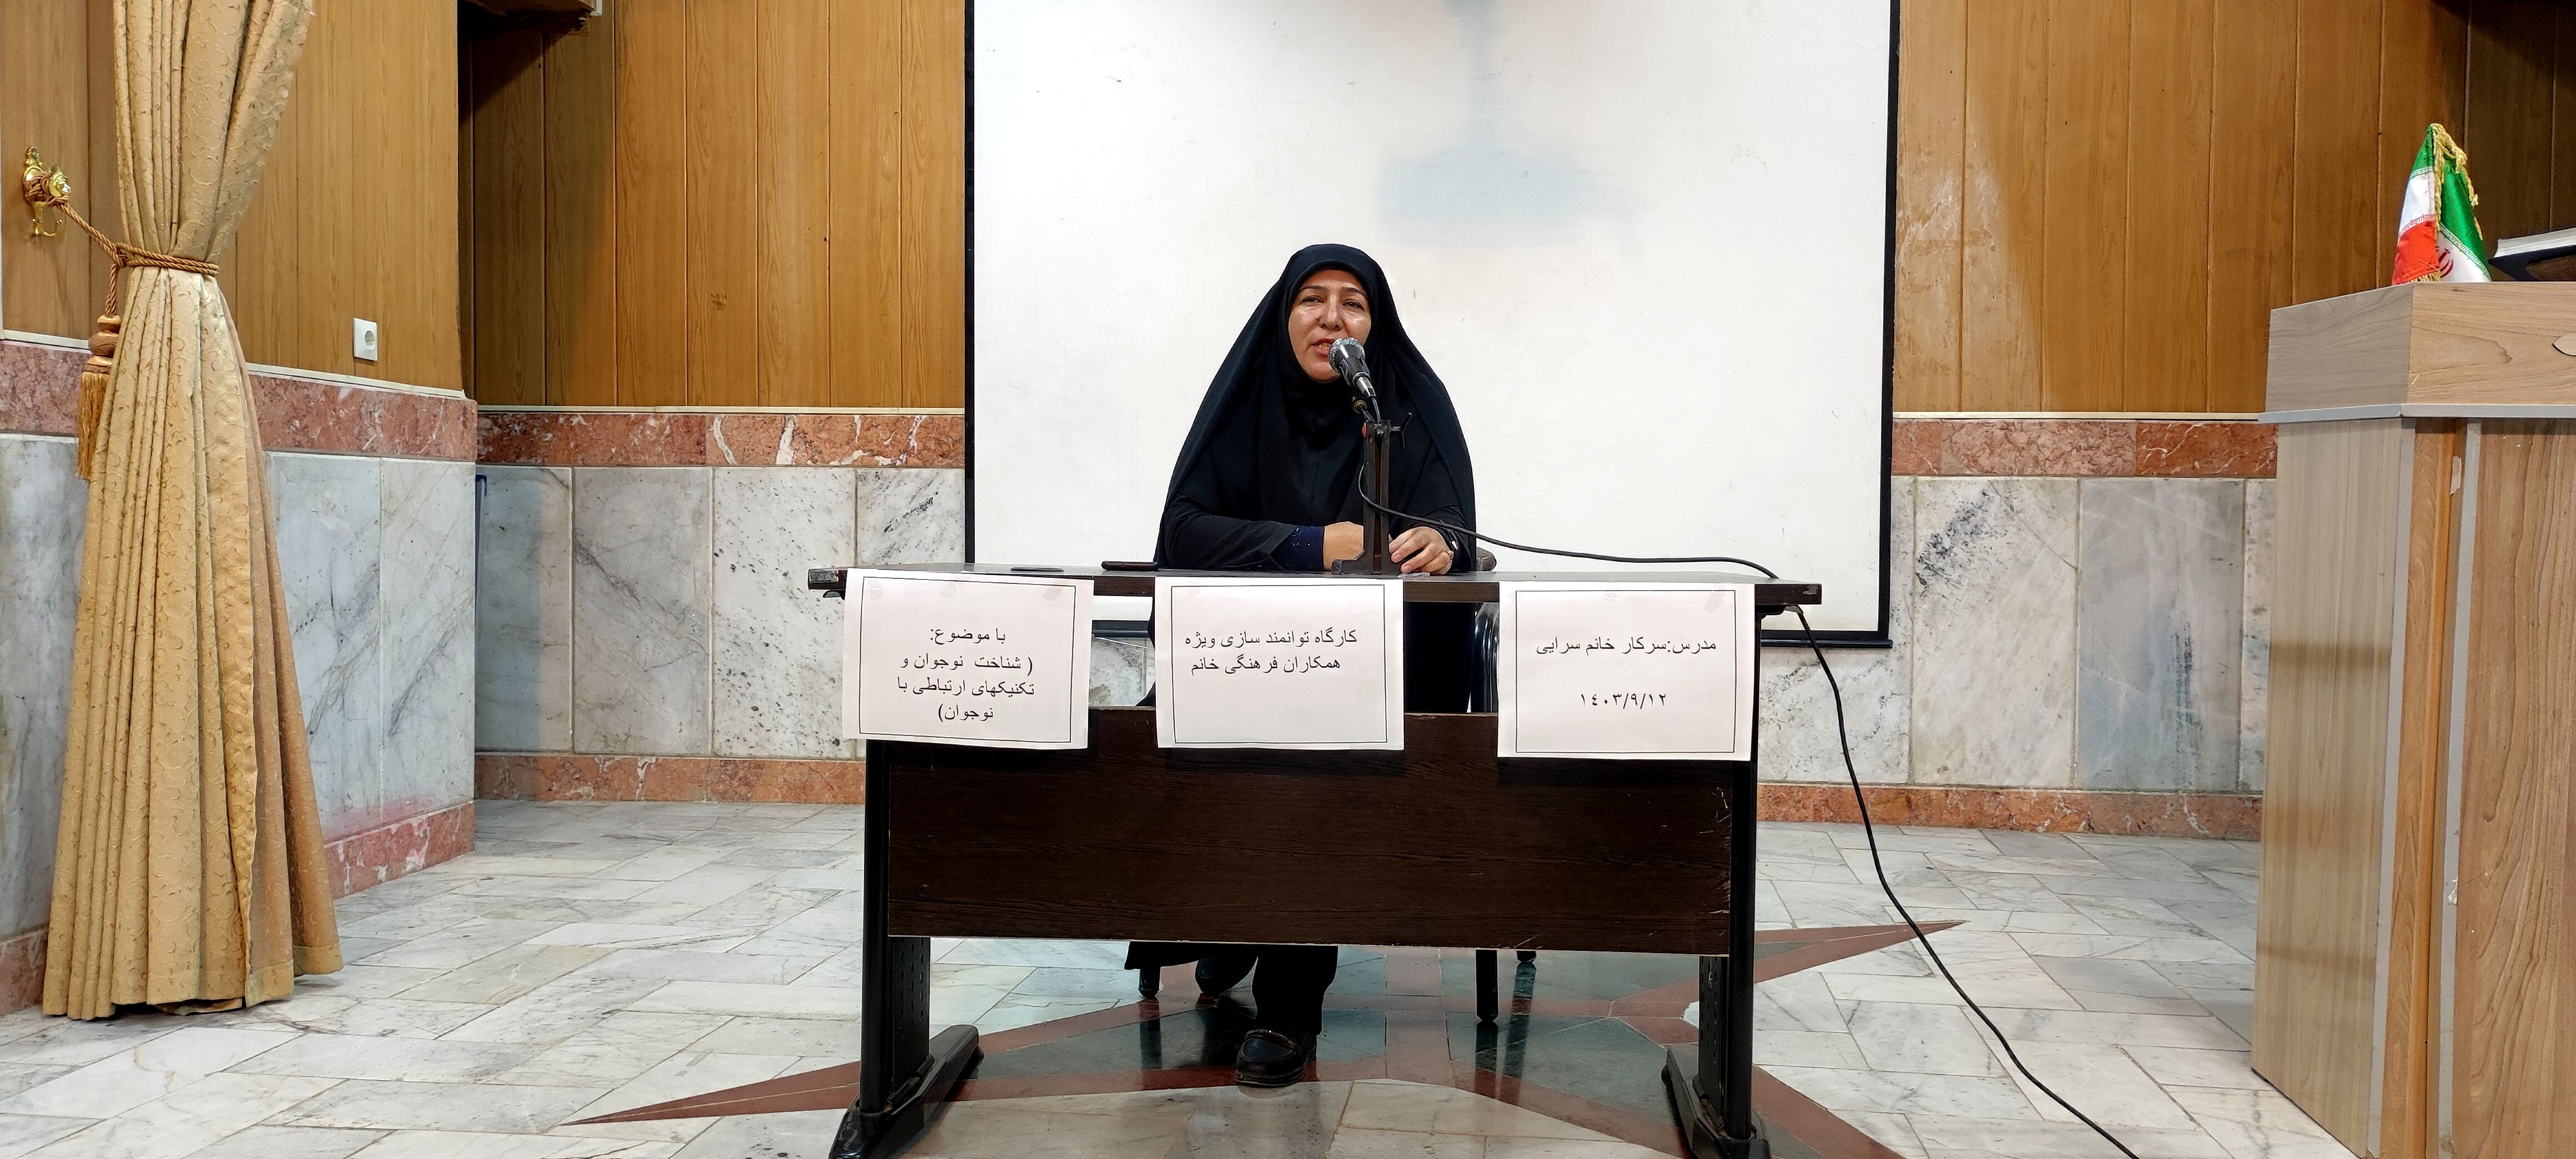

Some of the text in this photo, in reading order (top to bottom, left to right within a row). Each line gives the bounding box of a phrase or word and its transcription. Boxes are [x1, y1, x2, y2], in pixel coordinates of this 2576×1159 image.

[930, 627, 1005, 646] با موضوع:
[1185, 626, 1357, 649] کارگاه توانمند سازی ویژه
[1536, 636, 1581, 654] سرایی
[1586, 636, 1615, 656] خانم
[900, 658, 908, 668] و
[914, 652, 963, 671] نوجوان
[1191, 653, 1340, 677] همکاران فرهنگی خانم
[897, 676, 1034, 698] تکنیکهای ارتباطی با
[938, 703, 993, 723] نوجوان)
